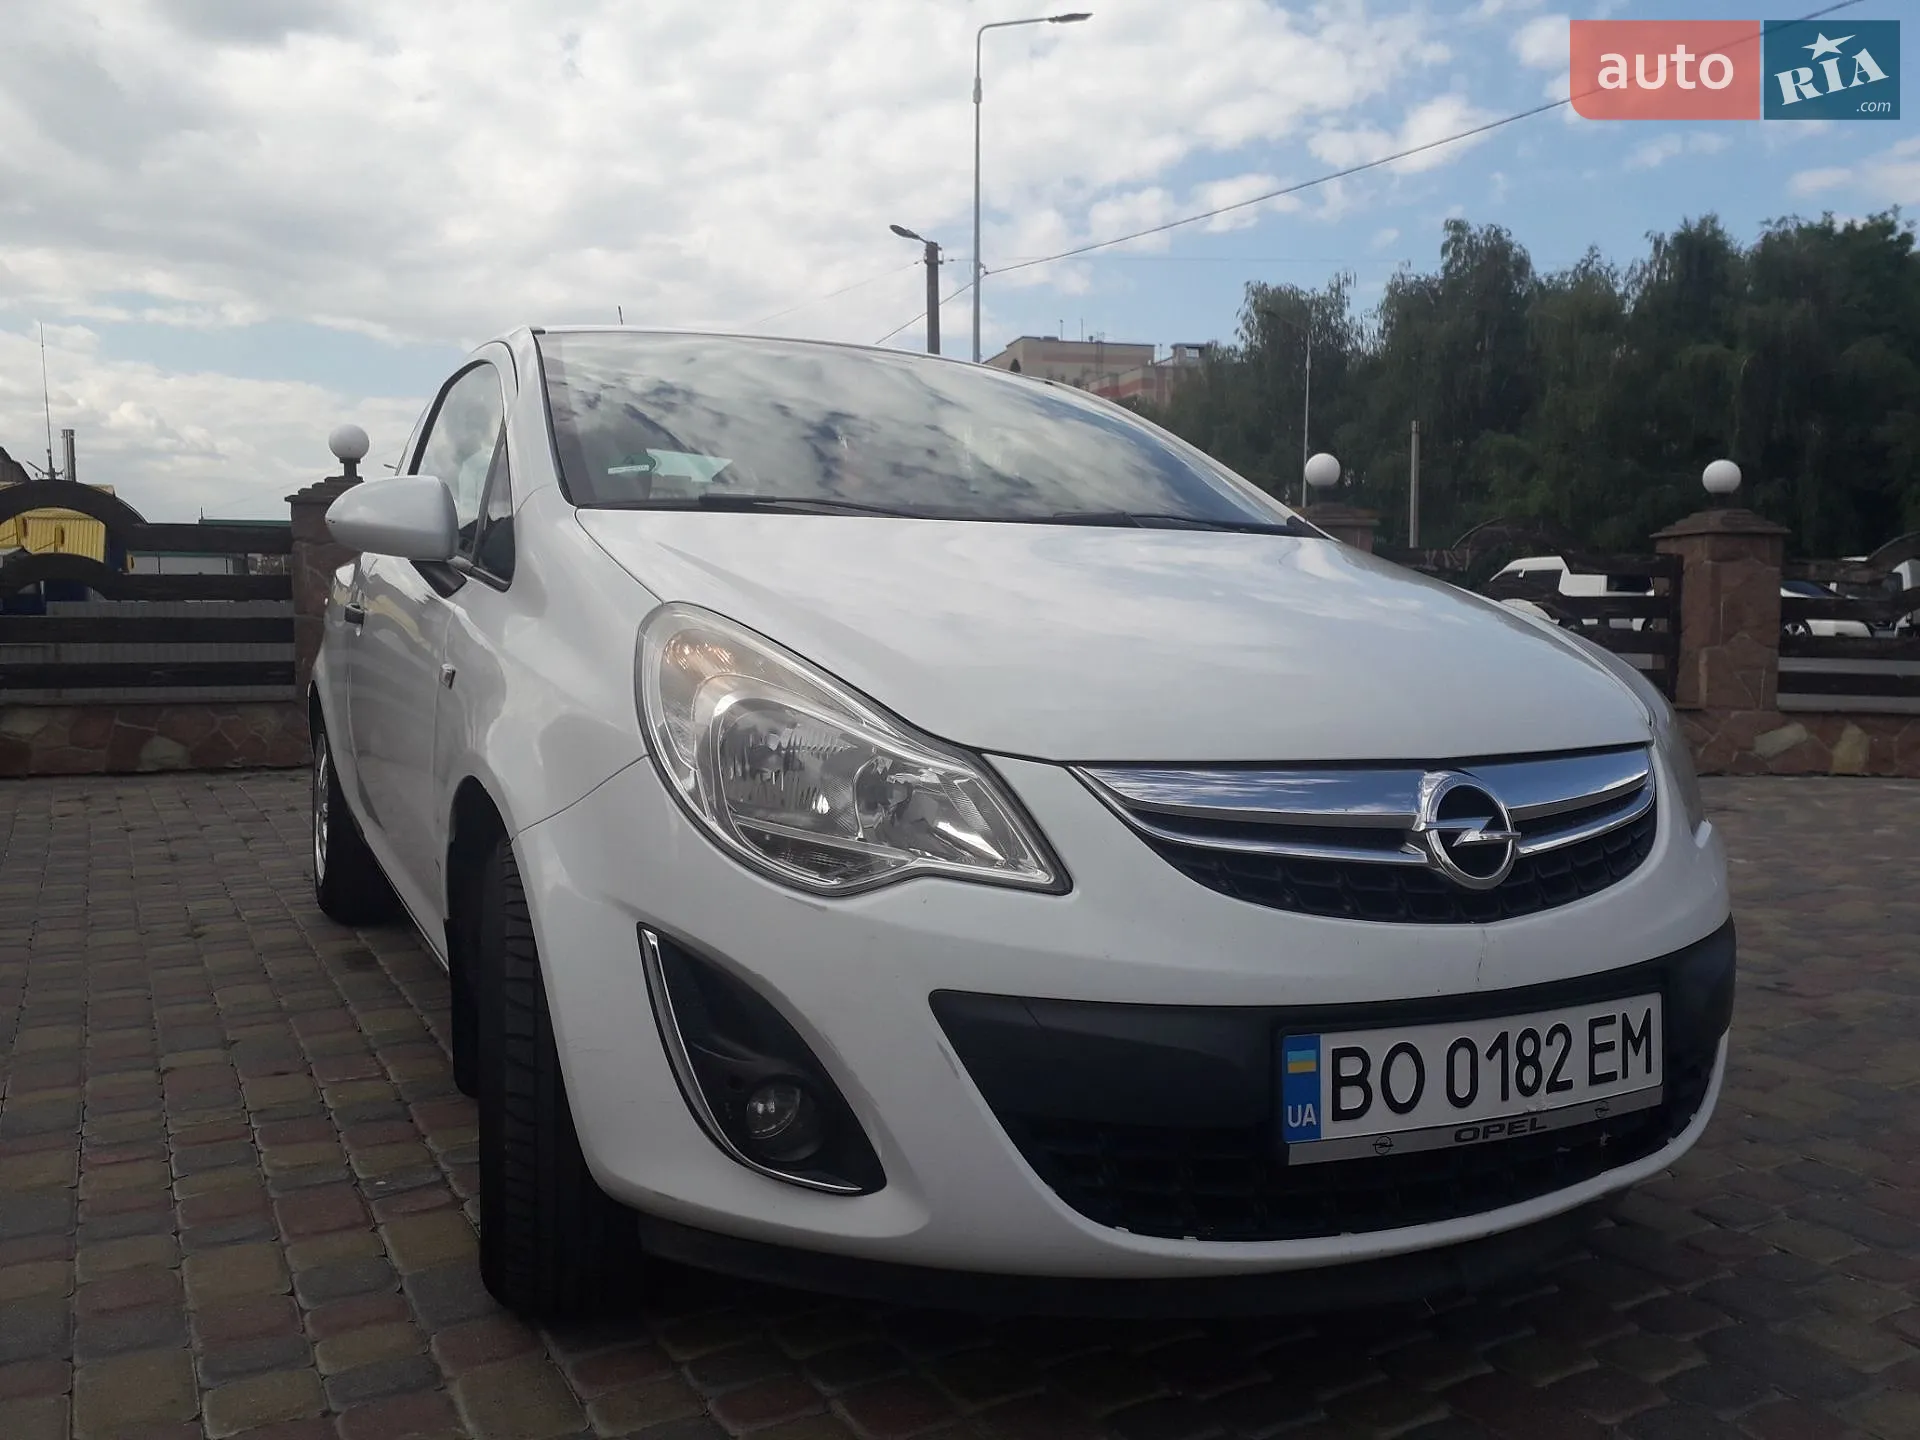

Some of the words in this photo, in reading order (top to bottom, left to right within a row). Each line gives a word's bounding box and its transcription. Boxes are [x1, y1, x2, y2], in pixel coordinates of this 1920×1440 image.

[1331, 1041, 1426, 1122] BO
[1446, 1022, 1573, 1109] 0182
[1588, 1007, 1652, 1086] EM
[1287, 1103, 1317, 1128] UA
[1454, 1117, 1547, 1143] OPEL
